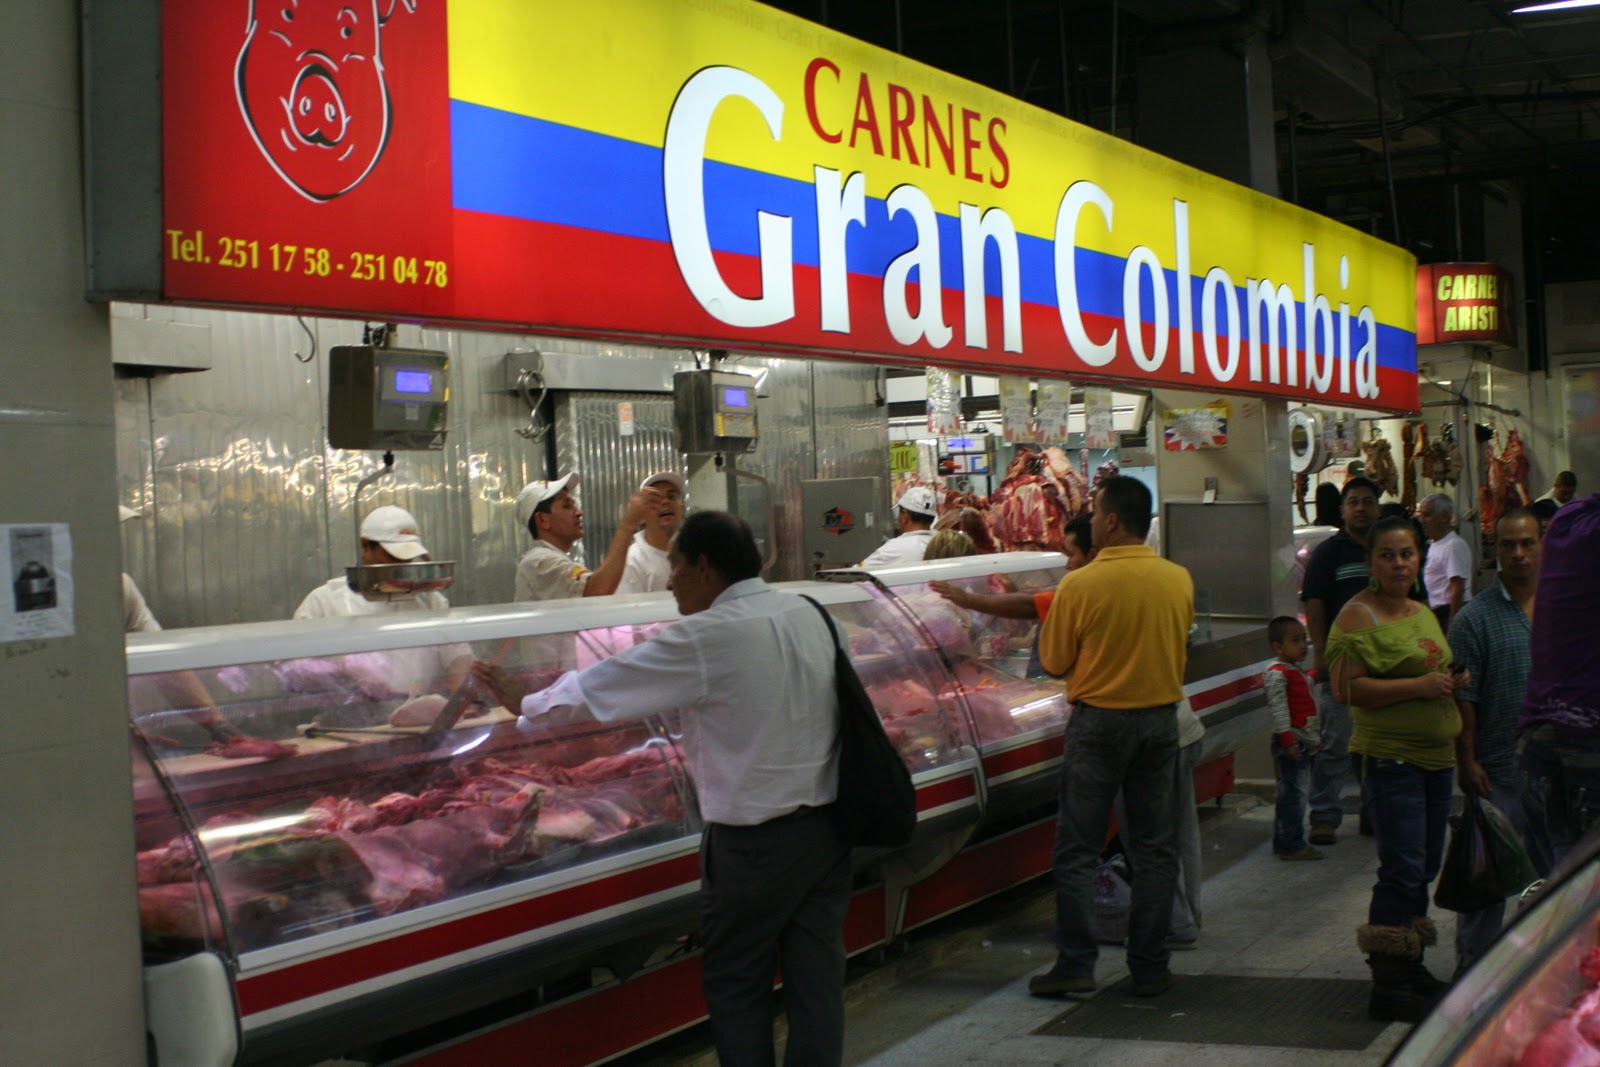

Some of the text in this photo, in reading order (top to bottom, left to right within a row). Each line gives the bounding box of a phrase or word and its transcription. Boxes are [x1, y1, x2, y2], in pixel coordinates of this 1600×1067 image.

[804, 57, 1009, 189] CARNES
[165, 229, 211, 264] Tel.
[218, 236, 259, 269] 251
[269, 243, 298, 272] 17
[303, 247, 331, 277] 58
[350, 251, 385, 281] 251
[392, 255, 419, 284] 04
[423, 259, 448, 288] 78
[664, 66, 1380, 400] Gran Colombia
